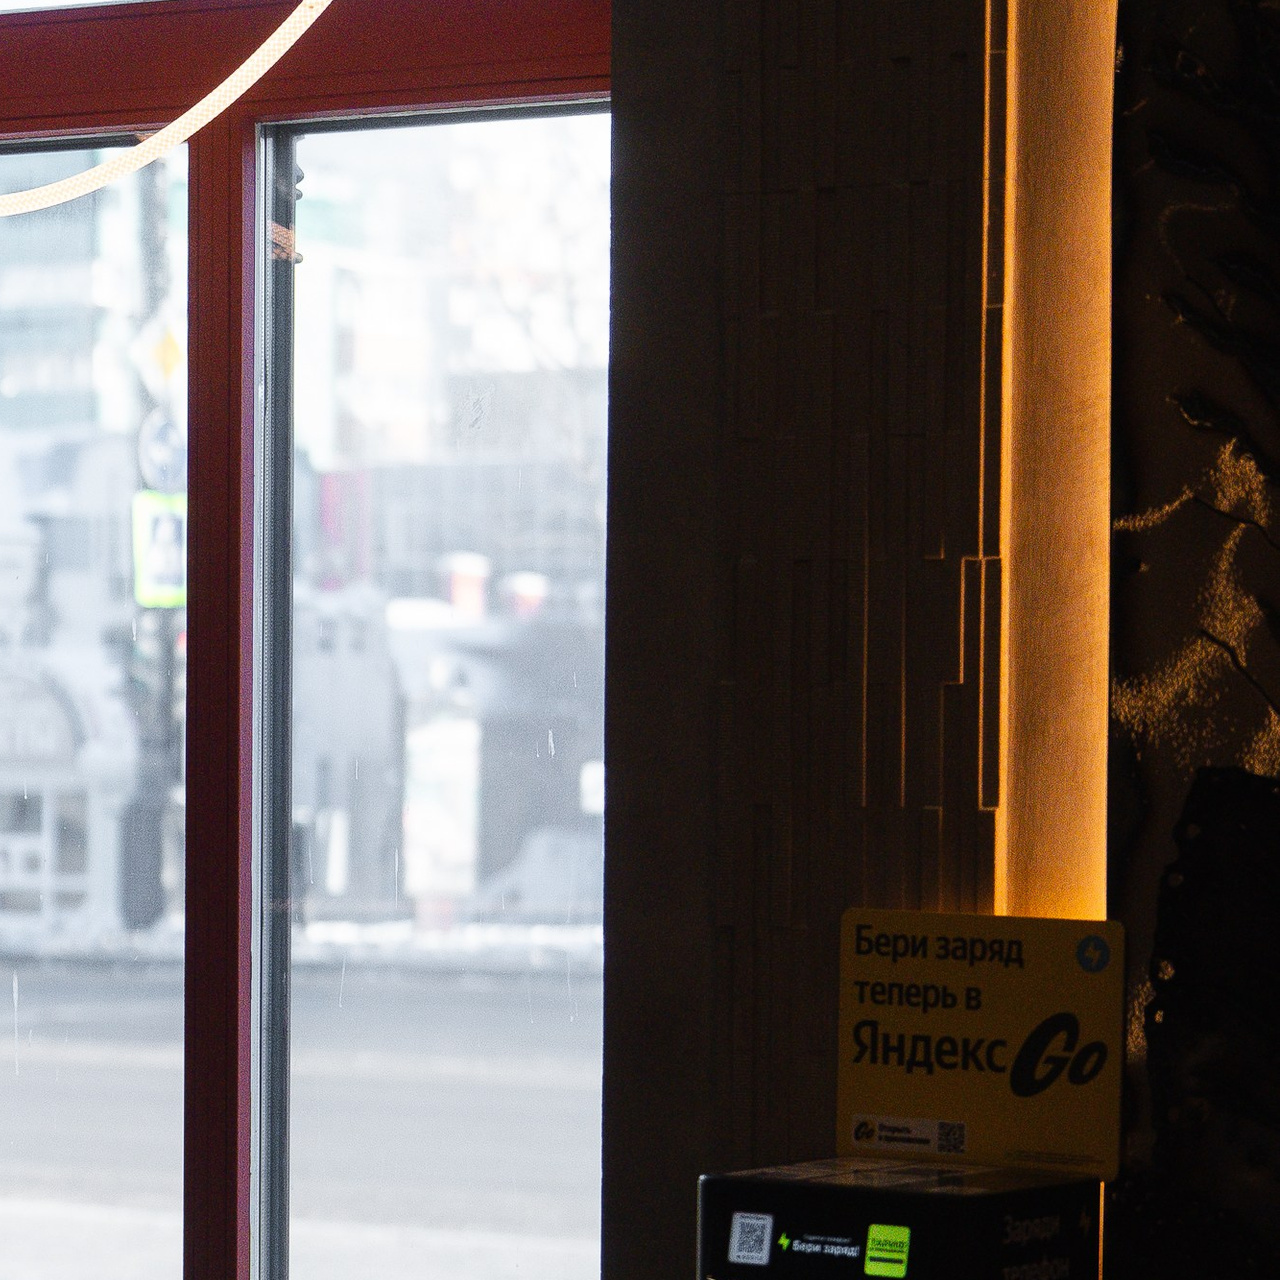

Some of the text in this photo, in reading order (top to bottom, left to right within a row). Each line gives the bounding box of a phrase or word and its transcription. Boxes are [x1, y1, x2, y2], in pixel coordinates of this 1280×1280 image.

[855, 924, 1024, 968] Бери заряд
[853, 980, 982, 1013] теперь в
[852, 1012, 1108, 1097] Яндекс Go
